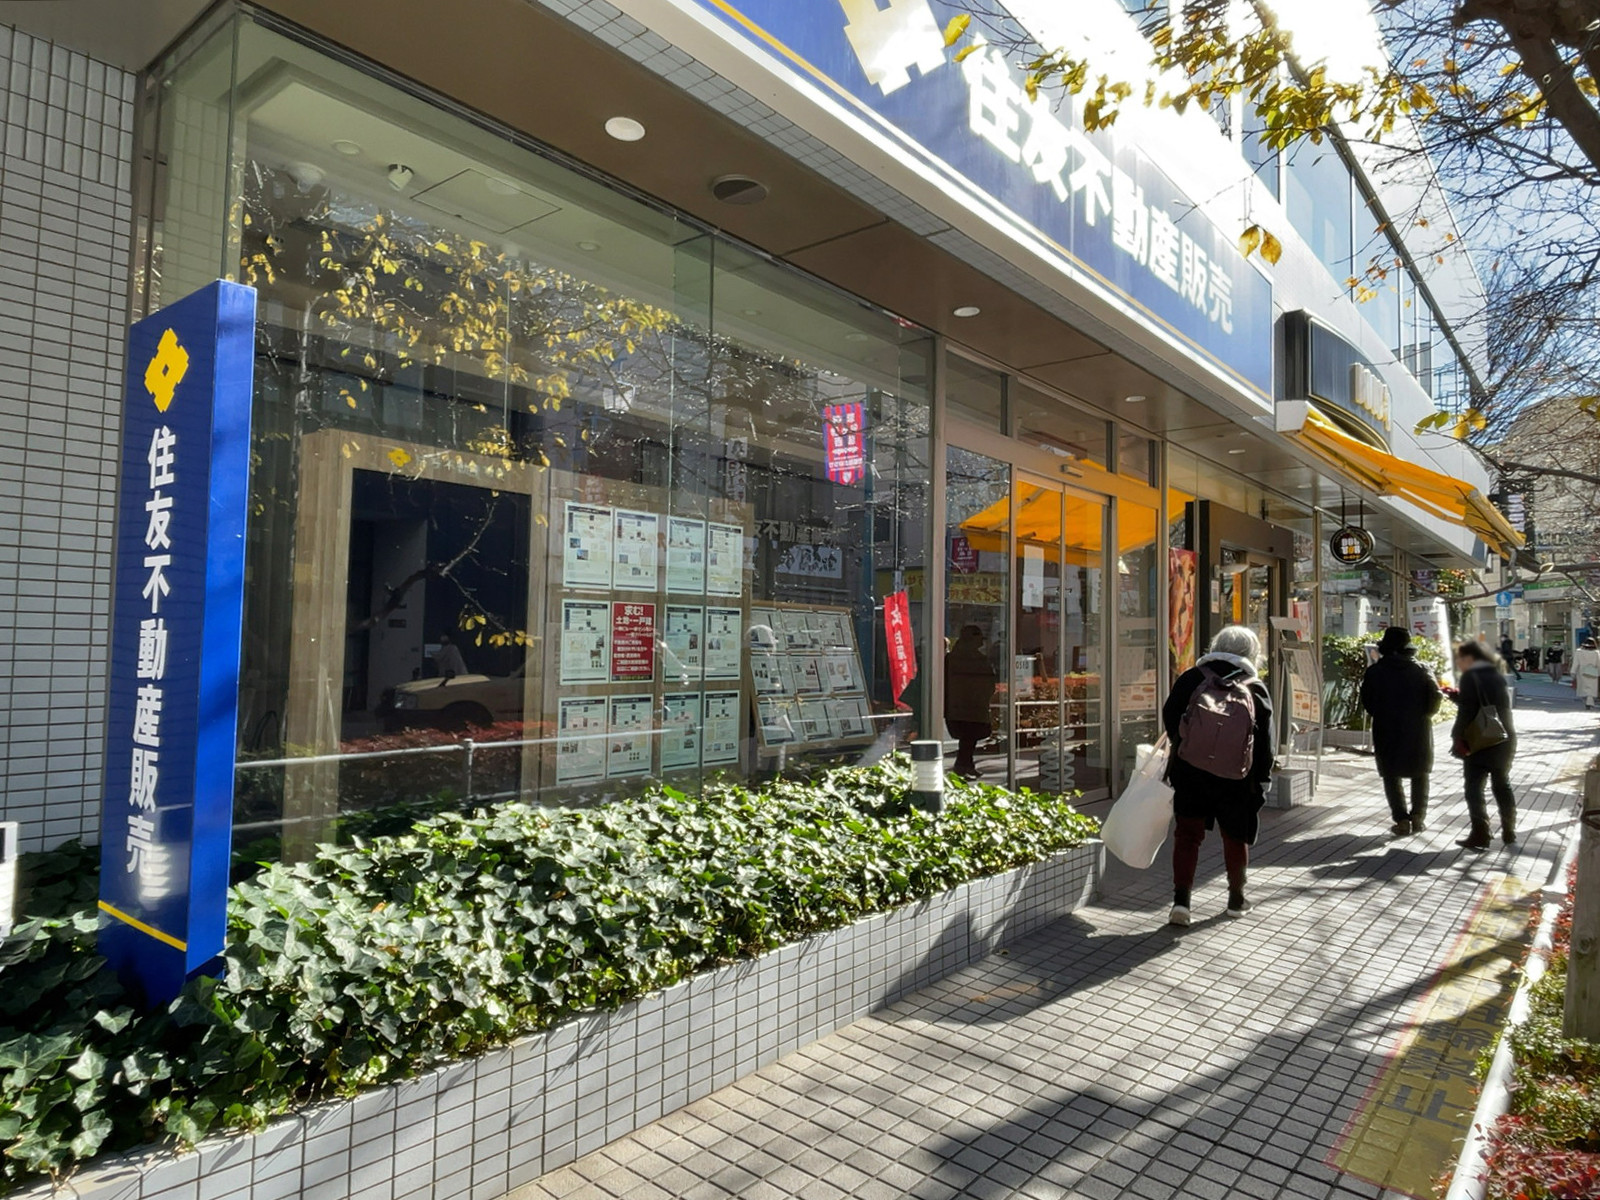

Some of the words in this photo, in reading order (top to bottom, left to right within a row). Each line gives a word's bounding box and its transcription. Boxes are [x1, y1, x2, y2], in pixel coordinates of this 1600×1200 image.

[961, 32, 1233, 335] 住友不動産販売
[126, 426, 178, 878] 住友不動産販売
